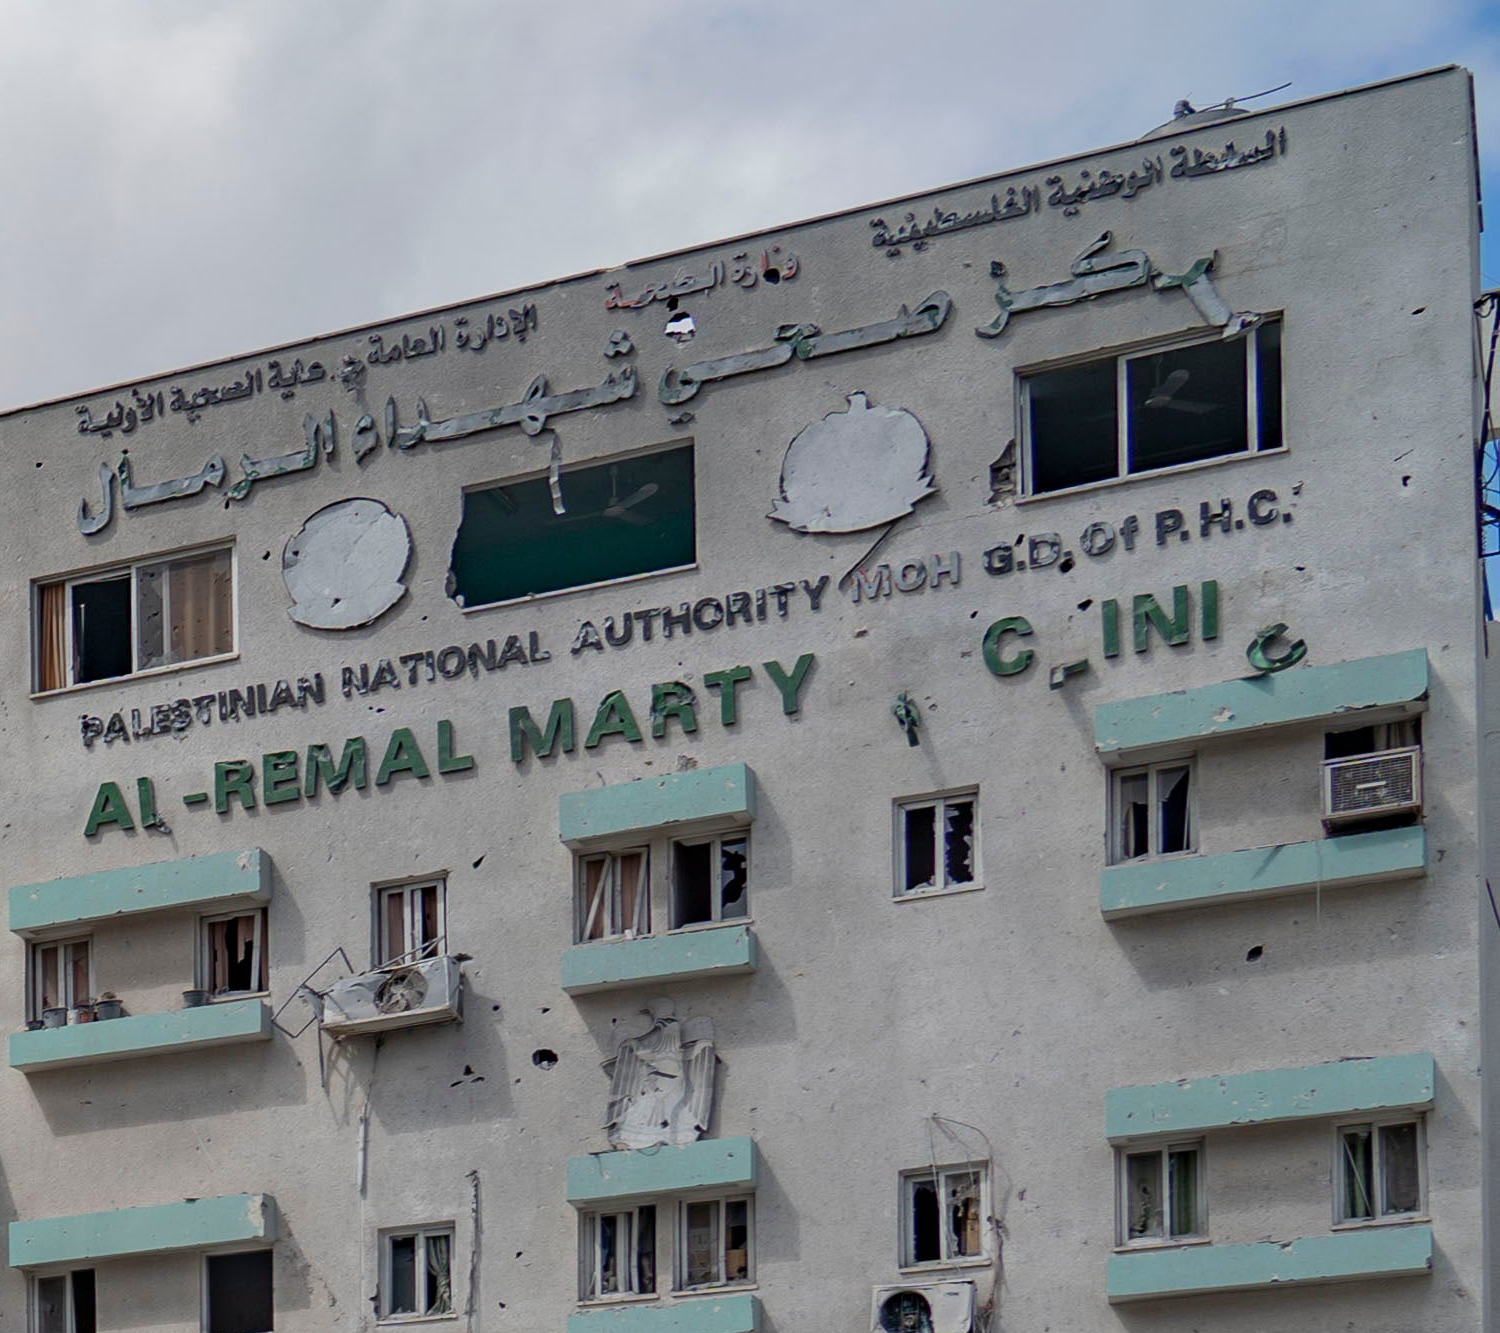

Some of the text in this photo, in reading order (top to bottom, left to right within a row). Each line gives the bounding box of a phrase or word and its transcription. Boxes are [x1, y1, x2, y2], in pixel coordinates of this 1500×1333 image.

[869, 126, 1287, 258] السلطة الوطنية الفلسطينية
[731, 244, 799, 288] وارة
[367, 323, 445, 365] العامة
[169, 367, 263, 423] الصحية
[76, 407, 336, 536] الرمال
[79, 672, 326, 747] PALESTINIAN
[341, 631, 551, 698] NATIONAL
[571, 574, 830, 655] AUTHORITY
[850, 550, 961, 604] MOH
